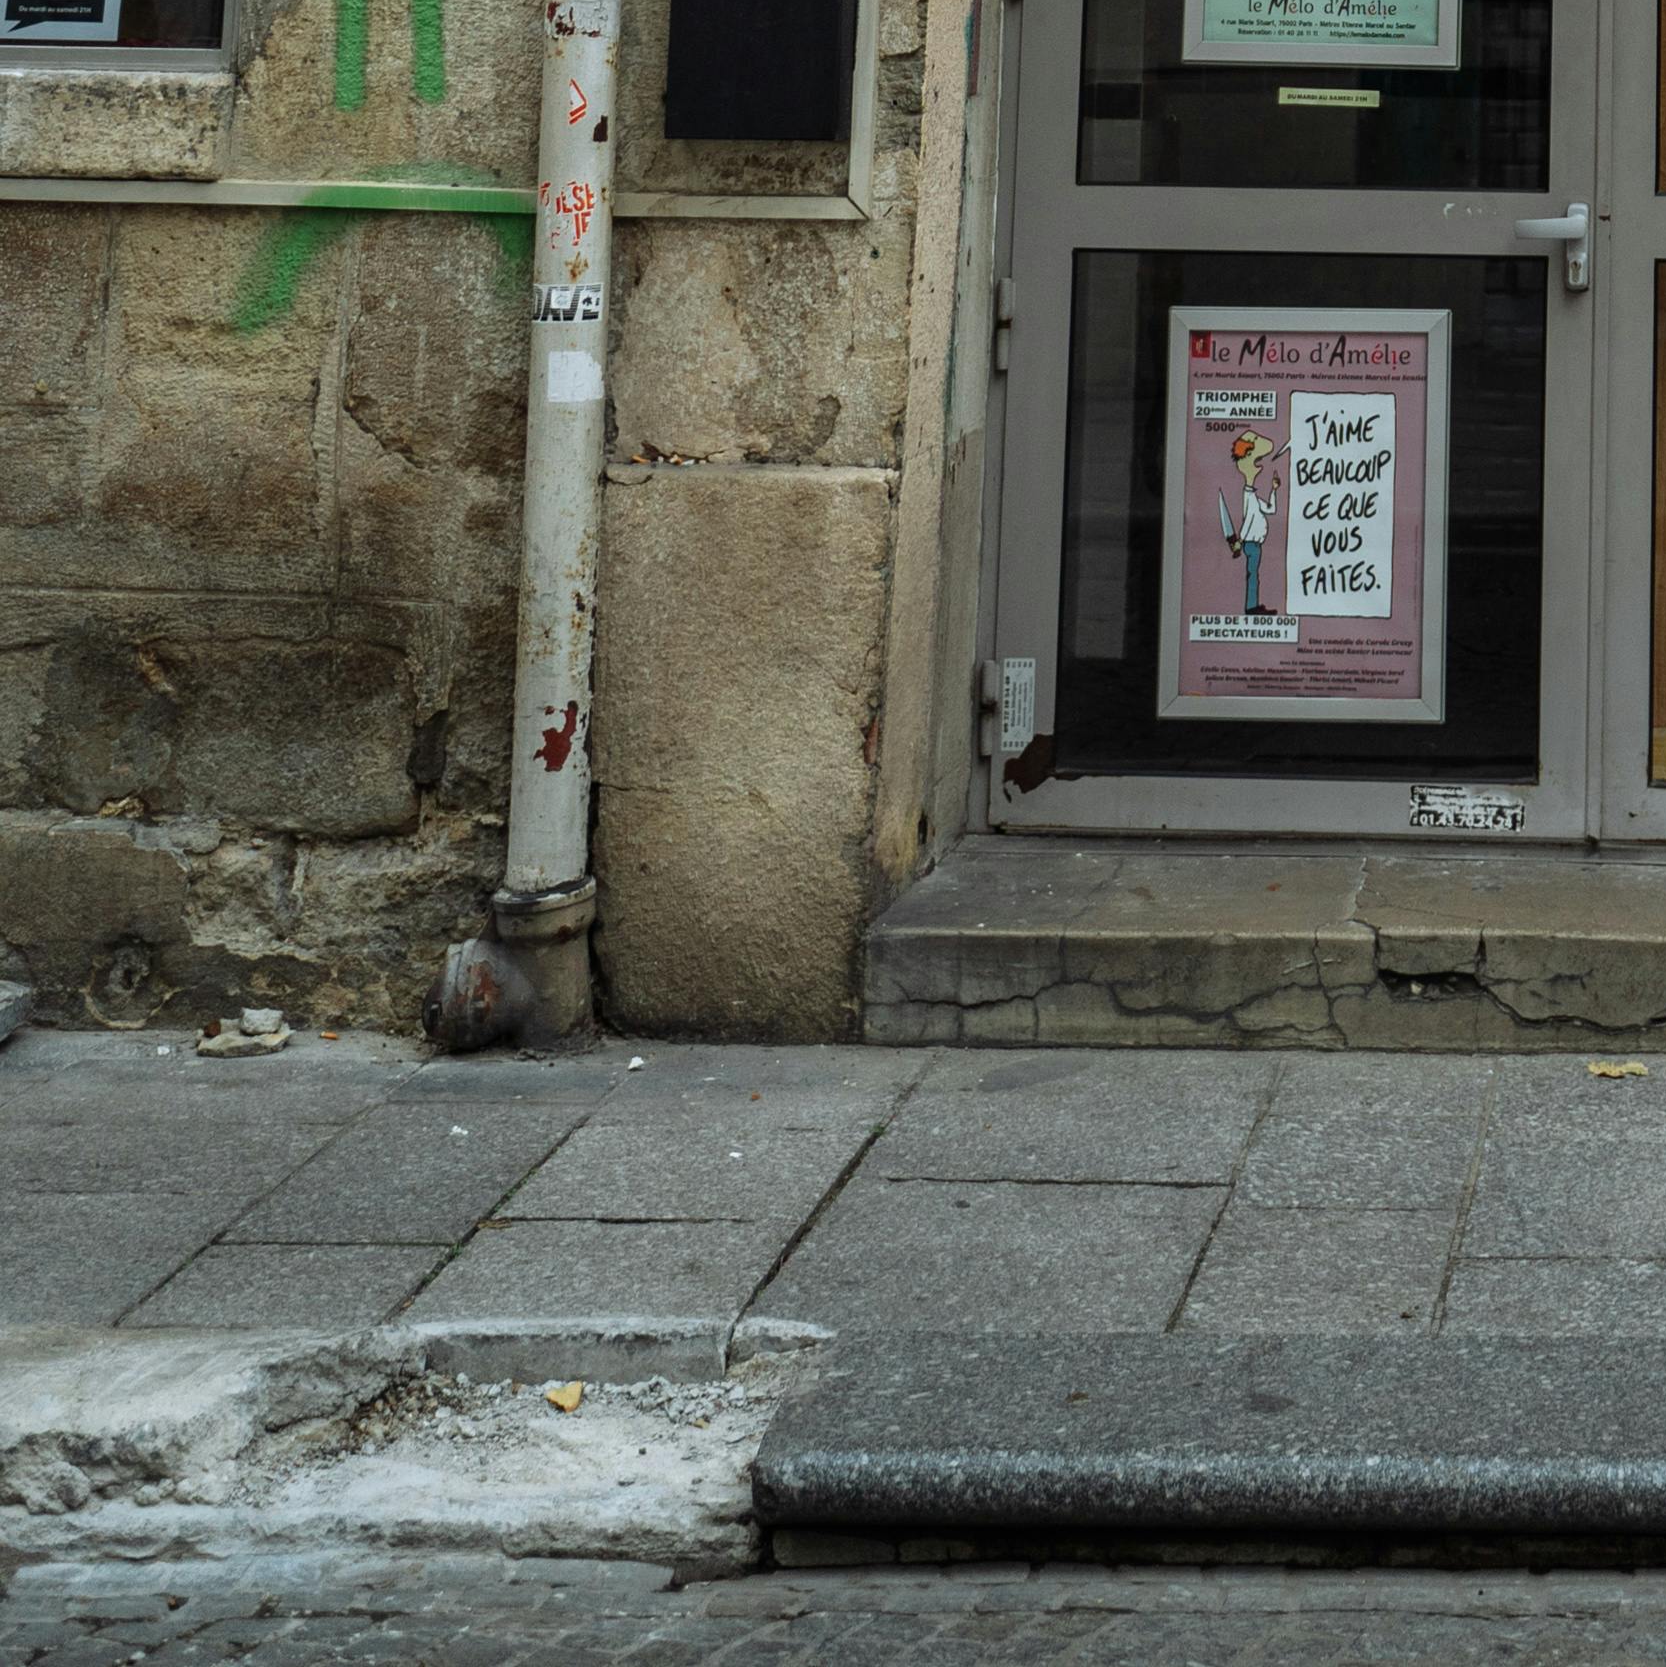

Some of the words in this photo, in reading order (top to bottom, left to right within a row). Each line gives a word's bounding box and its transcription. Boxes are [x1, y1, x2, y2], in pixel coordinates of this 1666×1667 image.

[1212, 340, 1230, 364] le
[1239, 335, 1300, 366] Mélo
[1310, 335, 1411, 370] d'Amélie
[1196, 392, 1274, 403] TRIOMPHE!
[1230, 405, 1274, 417] ANNÉE
[1296, 450, 1391, 486] BEAUCOUP
[1302, 493, 1332, 519] CE
[1337, 492, 1379, 520] QUE
[1311, 526, 1363, 557] VOUS
[1192, 616, 1221, 625] PLUS
[1224, 617, 1240, 625] DE
[1243, 617, 1248, 625] 1
[1253, 617, 1273, 626] 800
[1276, 617, 1297, 626] 000
[1199, 629, 1281, 639] SPECTATEURS
